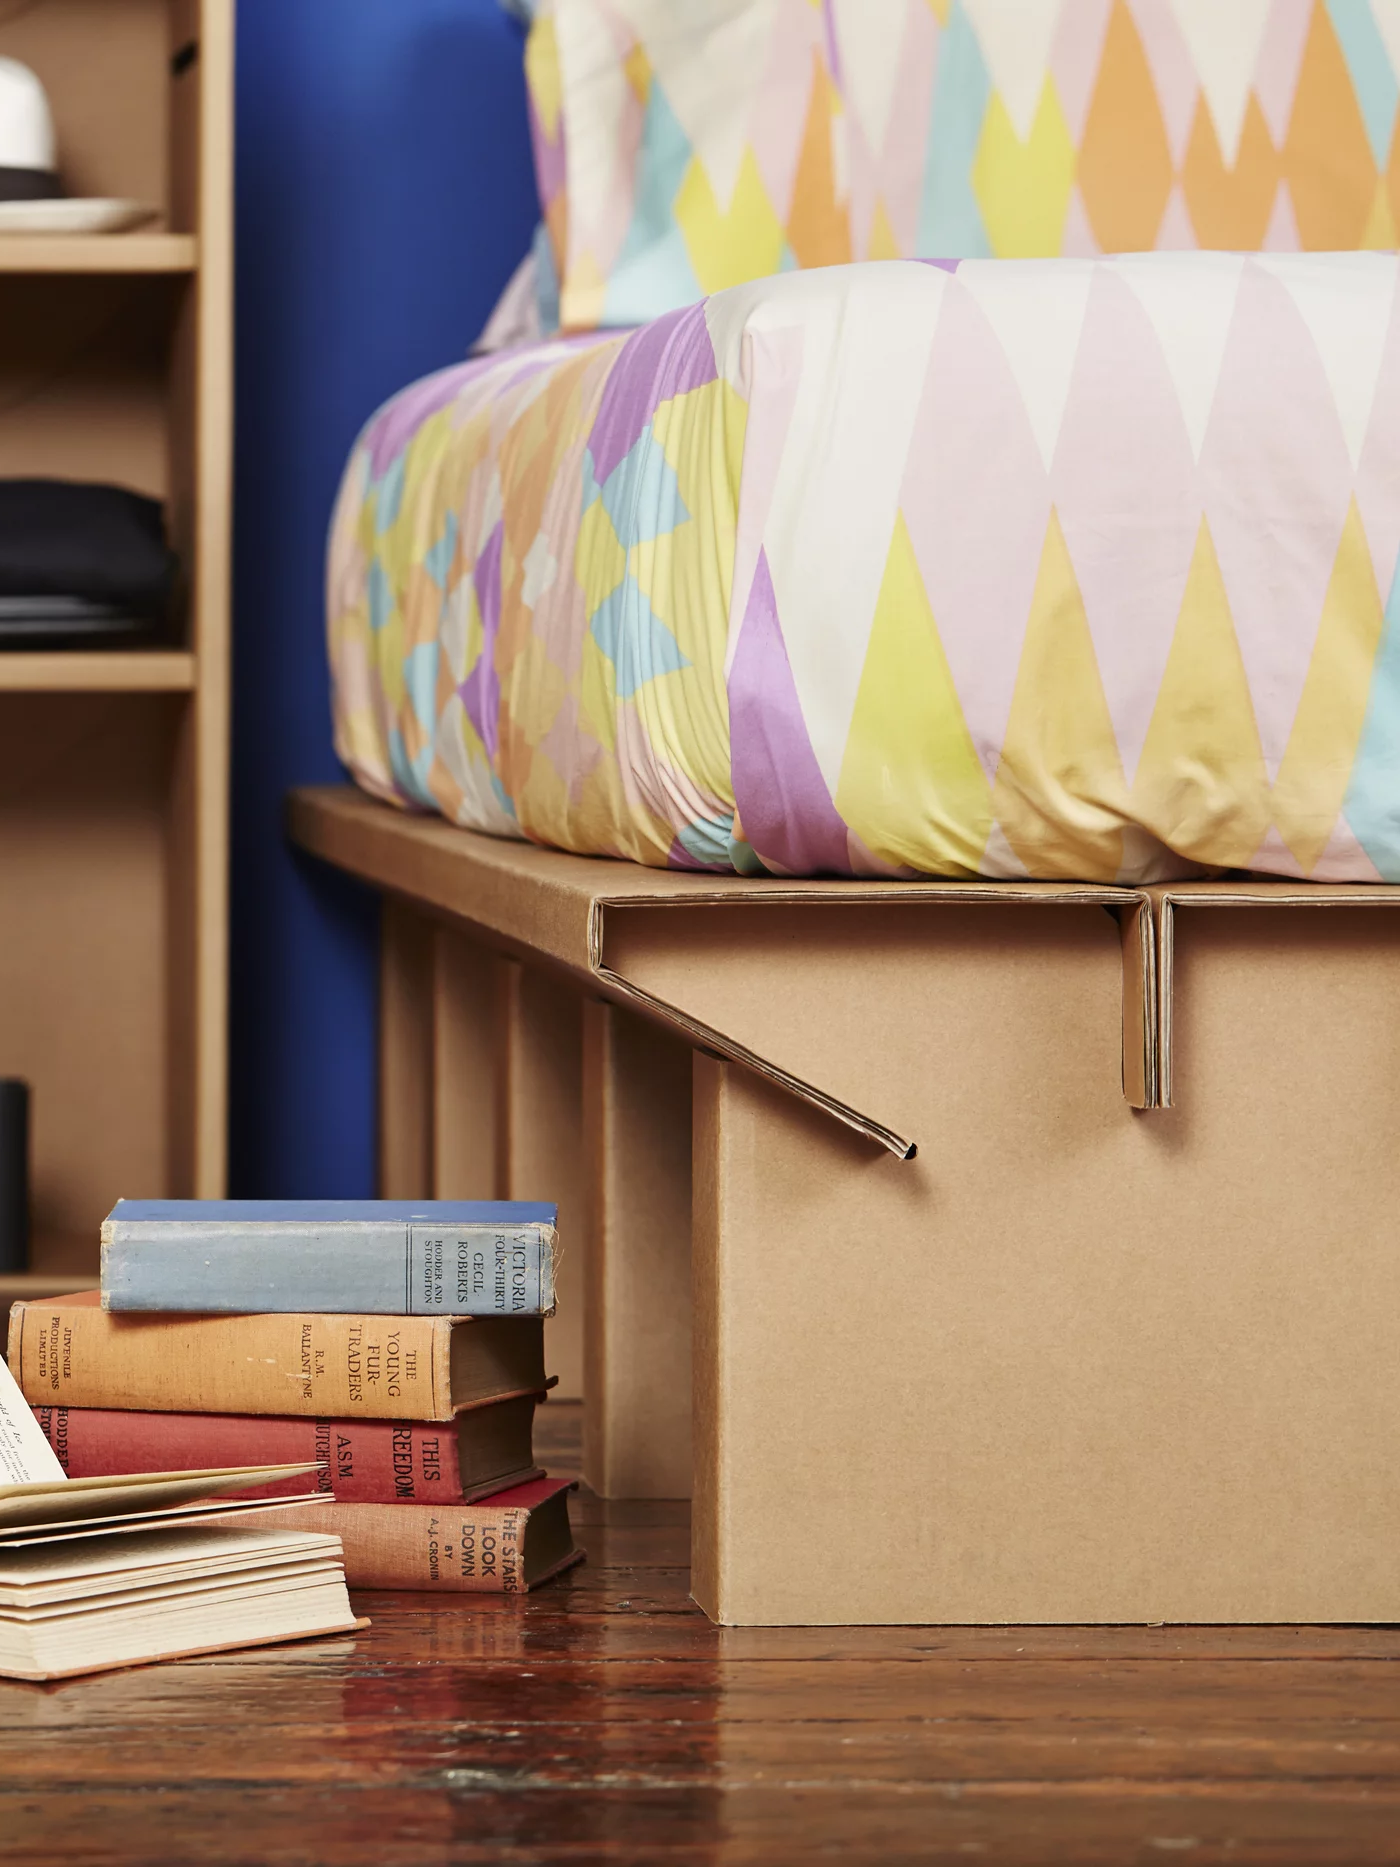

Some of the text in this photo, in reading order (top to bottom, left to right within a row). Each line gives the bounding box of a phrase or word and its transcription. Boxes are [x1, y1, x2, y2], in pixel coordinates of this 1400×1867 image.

[424, 1240, 433, 1304] STOUGHTON
[434, 1240, 443, 1304] HODDER AND
[457, 1241, 468, 1303] ROBERTS
[473, 1252, 484, 1293] CECIL
[495, 1234, 505, 1311] FOUR-THIRTY
[512, 1234, 526, 1312] VICTORIA
[39, 1329, 47, 1378] LIMITED
[50, 1316, 60, 1390] PRODUCTIONS
[63, 1327, 72, 1379] JUVENILE
[301, 1324, 313, 1399] BALLANTYNE
[347, 1324, 363, 1401] TRADERS
[366, 1345, 381, 1386] FUR-
[386, 1331, 401, 1397] YOUNG
[405, 1350, 417, 1380] THE
[5, 1418, 17, 1428] of
[12, 1431, 23, 1445] Ice
[421, 1437, 441, 1481] THIS
[429, 1541, 439, 1581] CRONIN
[444, 1545, 453, 1559] BY
[461, 1525, 475, 1577] DOWN
[481, 1527, 497, 1577] LOOK
[502, 1510, 519, 1593] THE STARS
